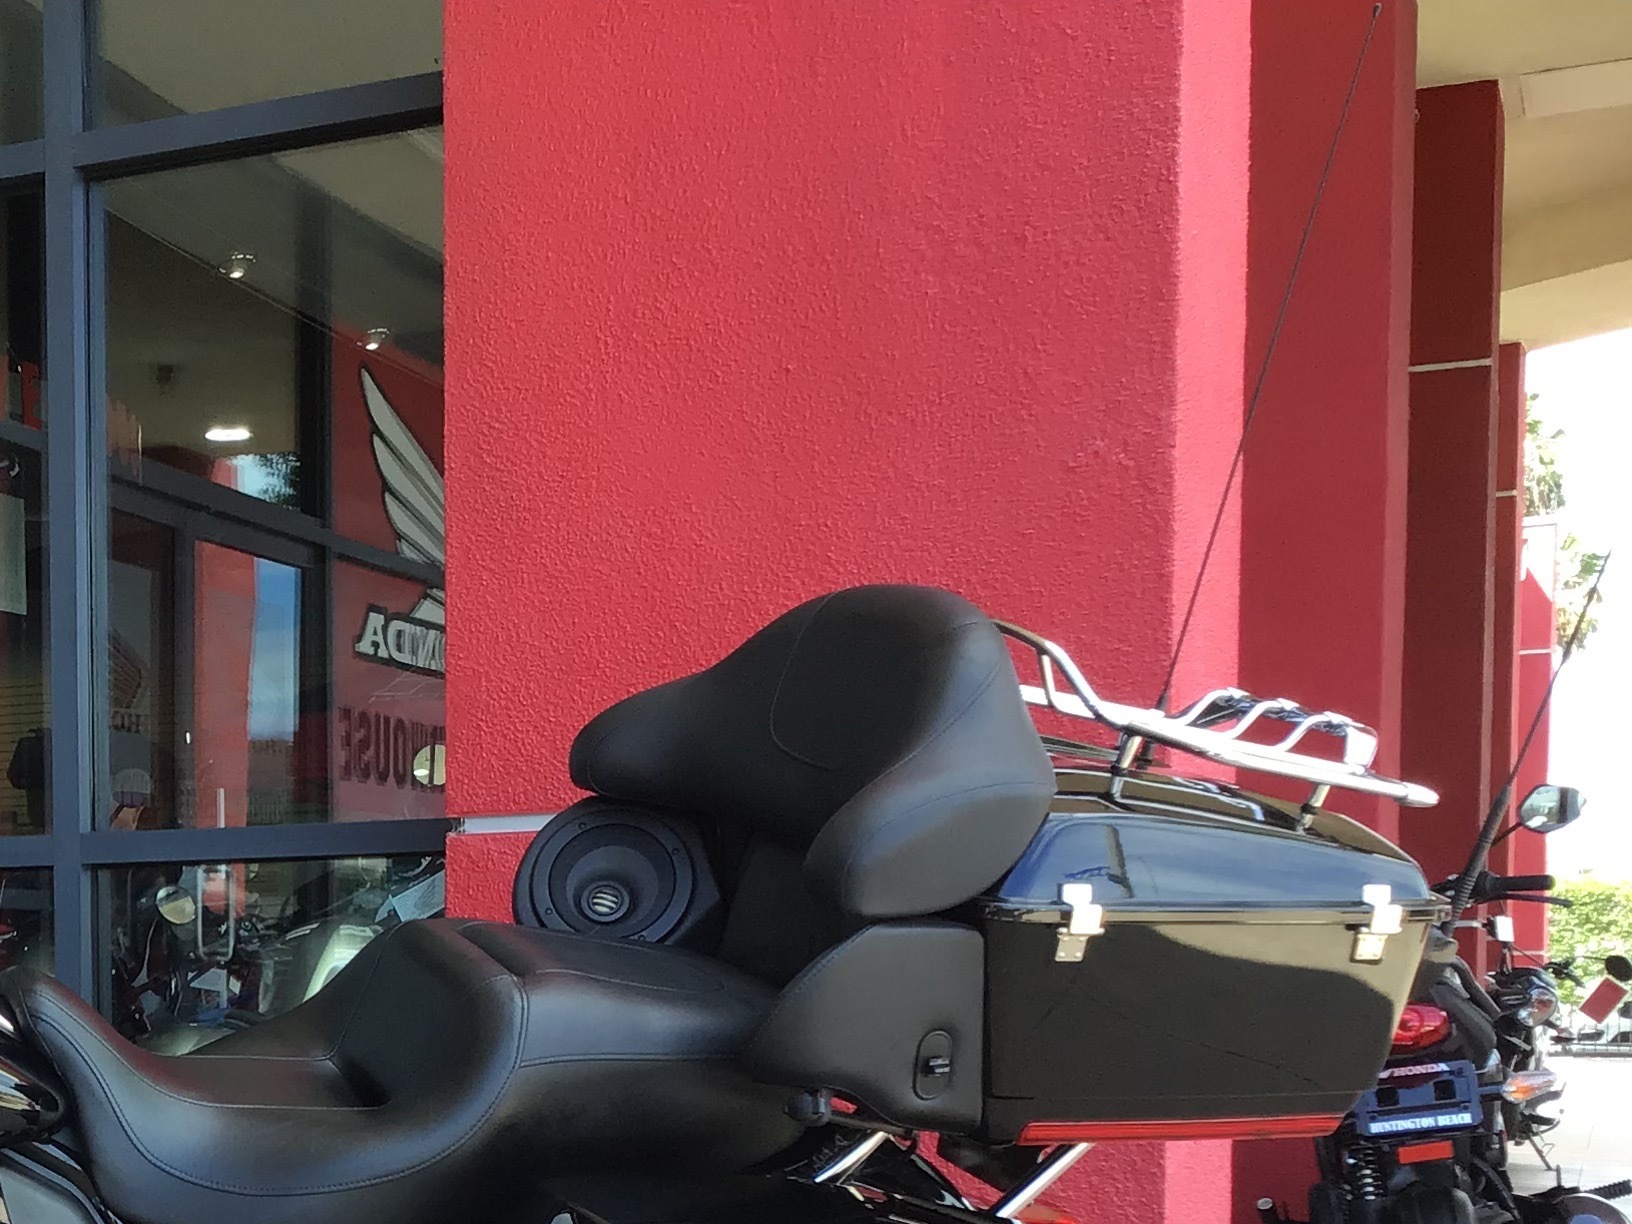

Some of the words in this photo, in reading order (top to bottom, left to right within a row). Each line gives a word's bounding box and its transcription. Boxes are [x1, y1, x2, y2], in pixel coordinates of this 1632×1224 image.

[1393, 1063, 1449, 1077] HONDA
[1369, 1117, 1435, 1134] HUNTINGTON
[1437, 1113, 1472, 1126] BEACH
